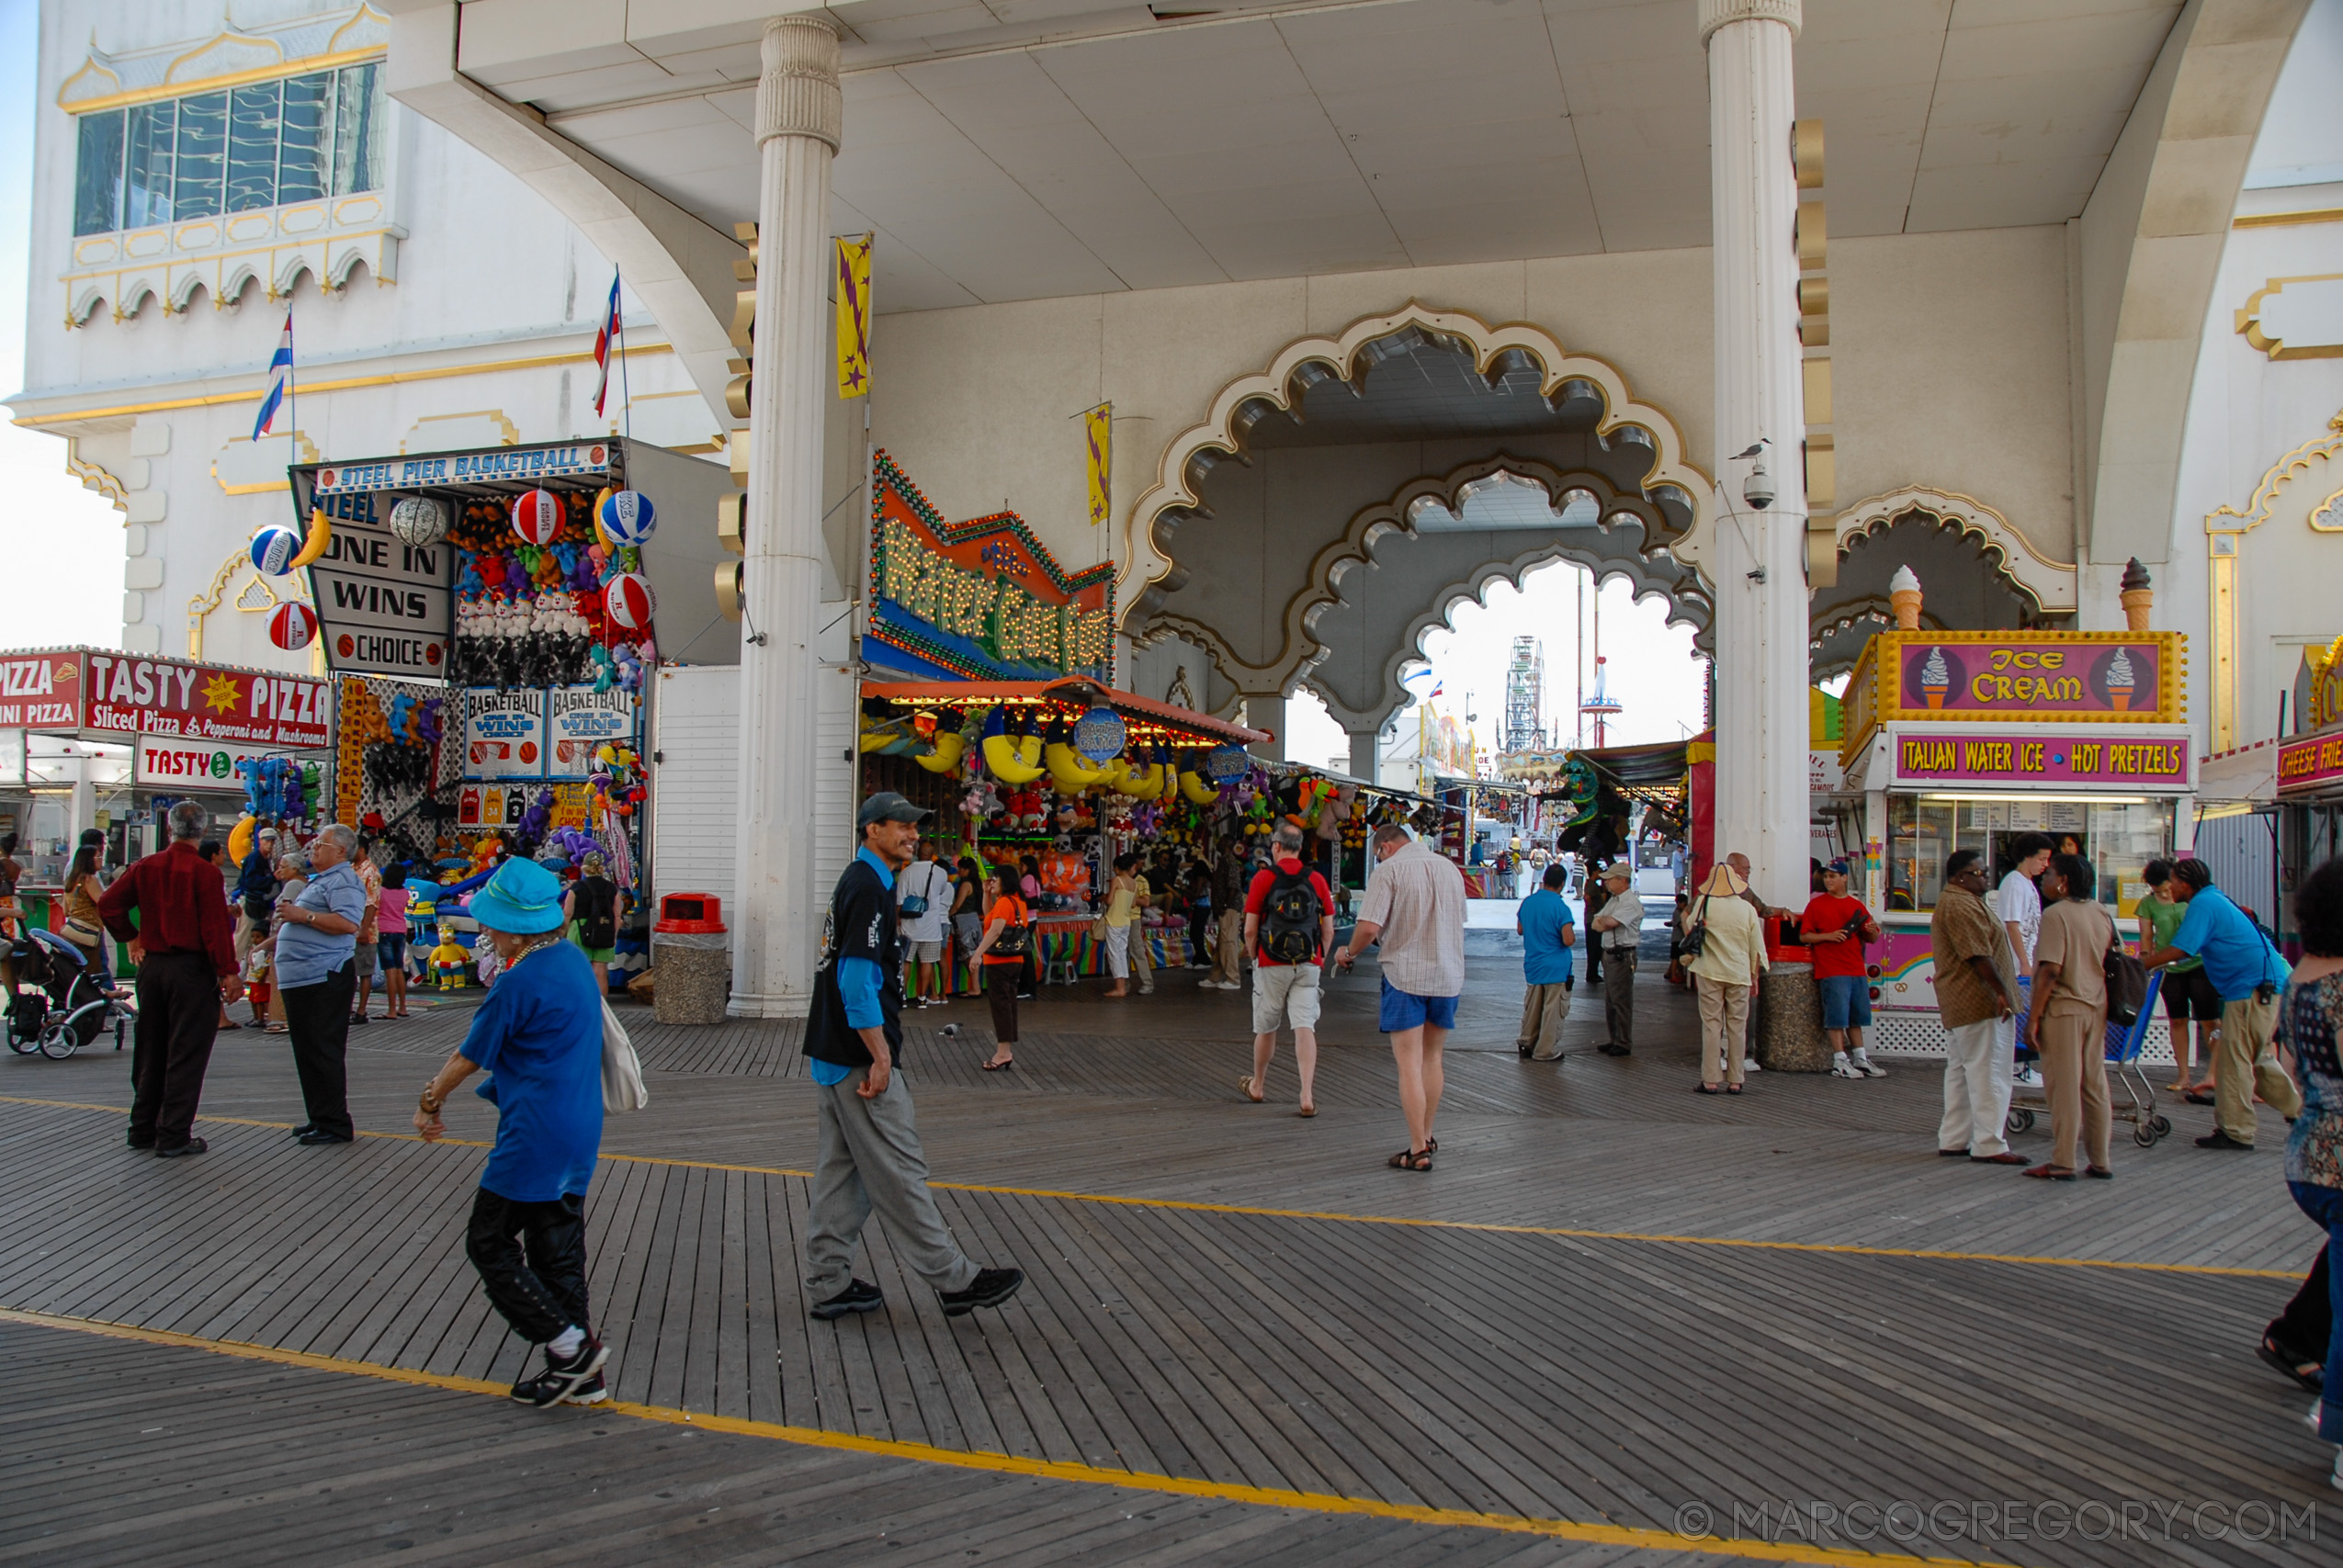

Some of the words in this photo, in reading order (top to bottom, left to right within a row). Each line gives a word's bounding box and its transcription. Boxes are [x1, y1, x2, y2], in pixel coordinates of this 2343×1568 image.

[341, 464, 394, 486] STEEL
[402, 459, 447, 481] PIER
[455, 447, 581, 477] BASKETBALL
[319, 533, 389, 569] ONE
[402, 542, 436, 575] IN
[332, 580, 426, 620] WINS
[357, 634, 423, 666] CHOICE
[1989, 649, 2066, 671] ICE
[92, 656, 197, 711] TASTY
[250, 676, 328, 726] PIZZA
[1971, 671, 2085, 706] CREAM
[27, 703, 74, 724] PIZZA
[469, 694, 542, 720] BASKETBALL
[553, 691, 630, 718] BASKETBALL
[93, 704, 137, 730] Sliced
[143, 710, 180, 734] Pizza
[203, 718, 251, 739] Pepperoni
[251, 726, 273, 740] and
[277, 727, 325, 745] Mushrooms
[475, 719, 534, 731] WINS
[560, 718, 622, 729] WINS
[1077, 721, 1124, 736] WATER
[341, 698, 352, 795] CHOICE
[350, 698, 363, 797] BASKETBALL
[1077, 736, 1120, 750] GAME
[145, 749, 210, 776] TASTY
[1903, 740, 1957, 773] ITALIAN
[1964, 741, 2014, 772] WATER
[2020, 742, 2045, 772] ICE
[2071, 743, 2103, 773] HOT
[2109, 744, 2181, 775] PRETZELS
[2281, 745, 2317, 779] CHEESE
[487, 807, 498, 817] 34
[512, 805, 520, 817] 3
[559, 817, 585, 827] CHOIC
[1810, 829, 1837, 838] VERAGES
